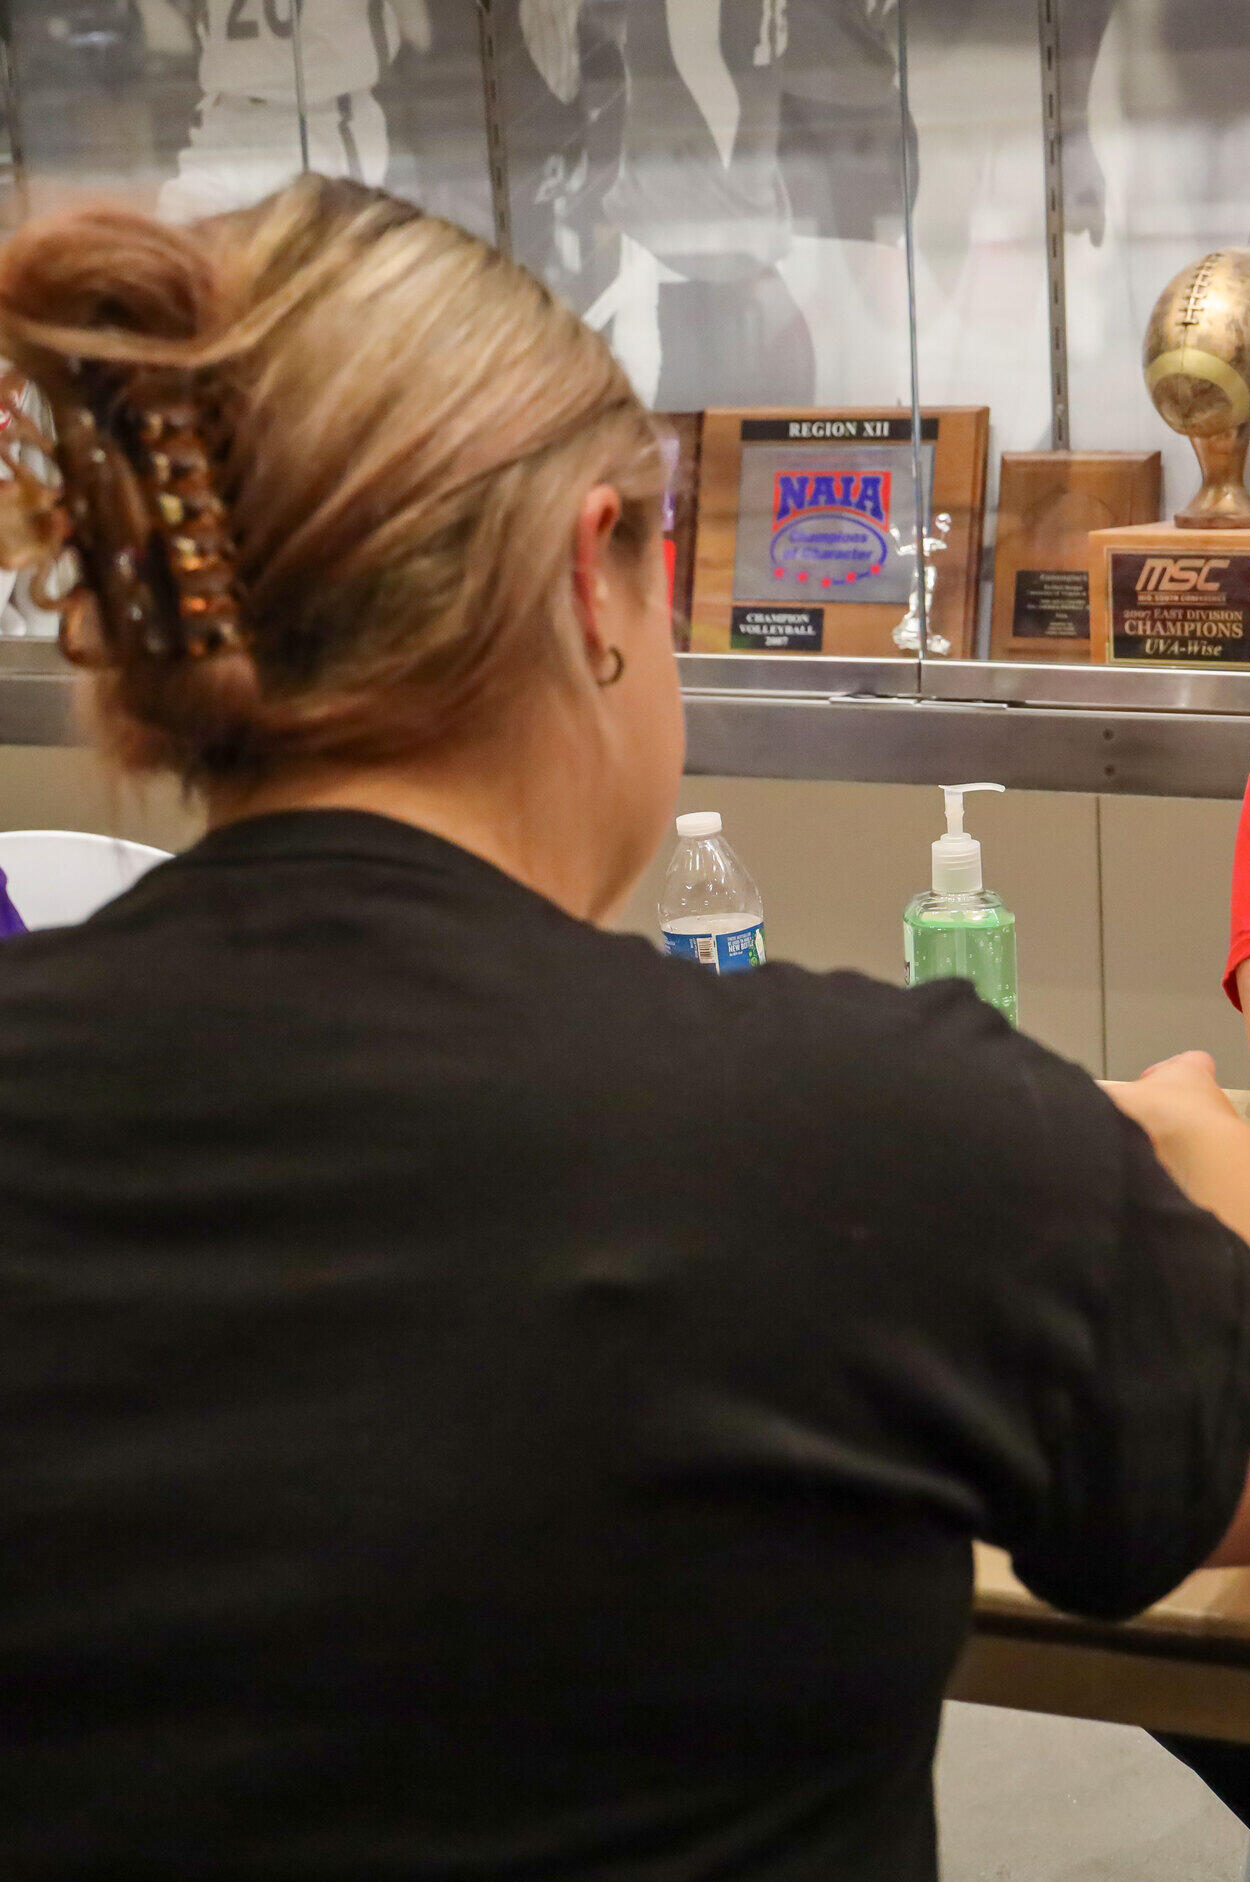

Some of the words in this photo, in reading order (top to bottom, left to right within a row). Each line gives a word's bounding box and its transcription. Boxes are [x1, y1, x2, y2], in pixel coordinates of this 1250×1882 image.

[788, 421, 858, 438] REGION
[863, 421, 890, 437] XII
[776, 475, 884, 522] NAIA
[1134, 558, 1231, 591] MSC
[745, 612, 810, 624] CHAMPION
[1154, 608, 1184, 619] EAST
[1186, 609, 1244, 621] DIVISION
[739, 624, 816, 636] VOLLEYBALL
[1123, 620, 1244, 639] CHAMPIONS
[1144, 638, 1223, 657] UVA-Wise
